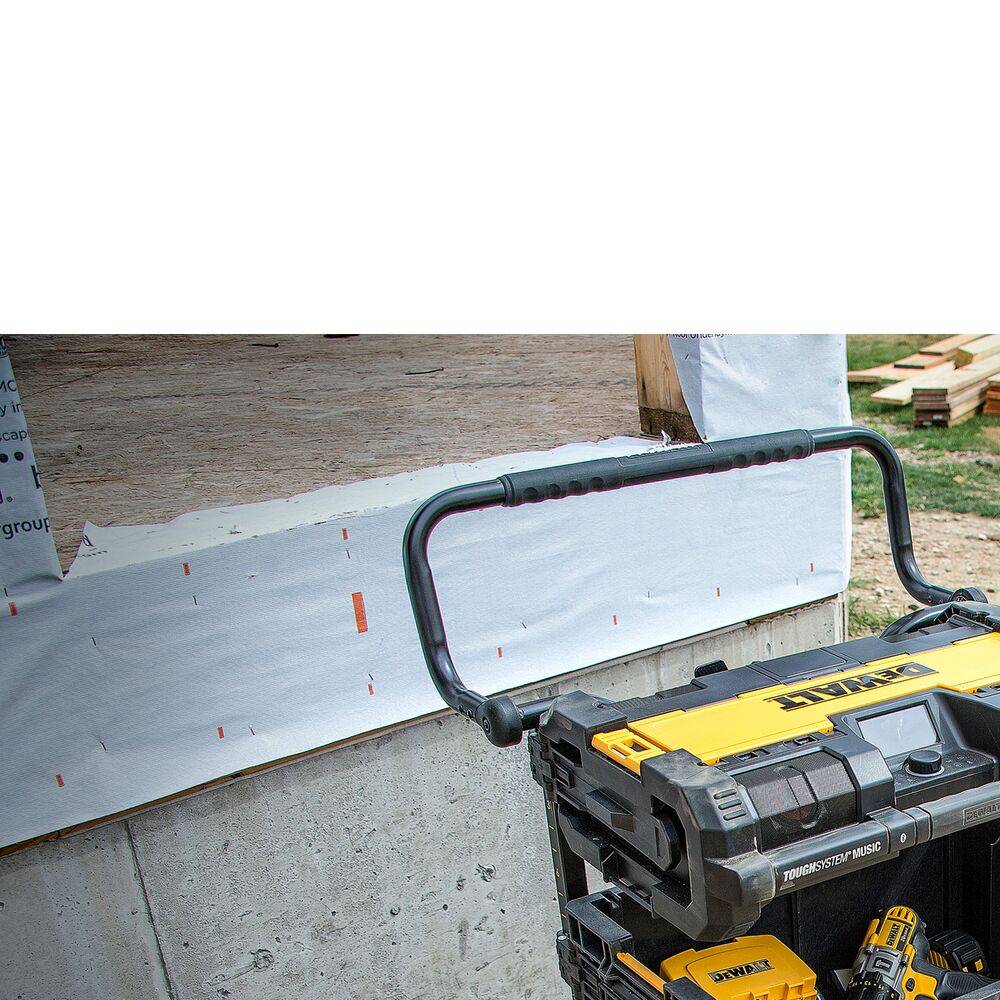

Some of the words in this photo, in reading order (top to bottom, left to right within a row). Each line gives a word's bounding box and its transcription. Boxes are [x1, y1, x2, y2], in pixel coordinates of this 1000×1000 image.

[774, 662, 937, 710] DEWALT
[852, 841, 881, 860] MUSIC
[708, 960, 773, 983] DEWALT
